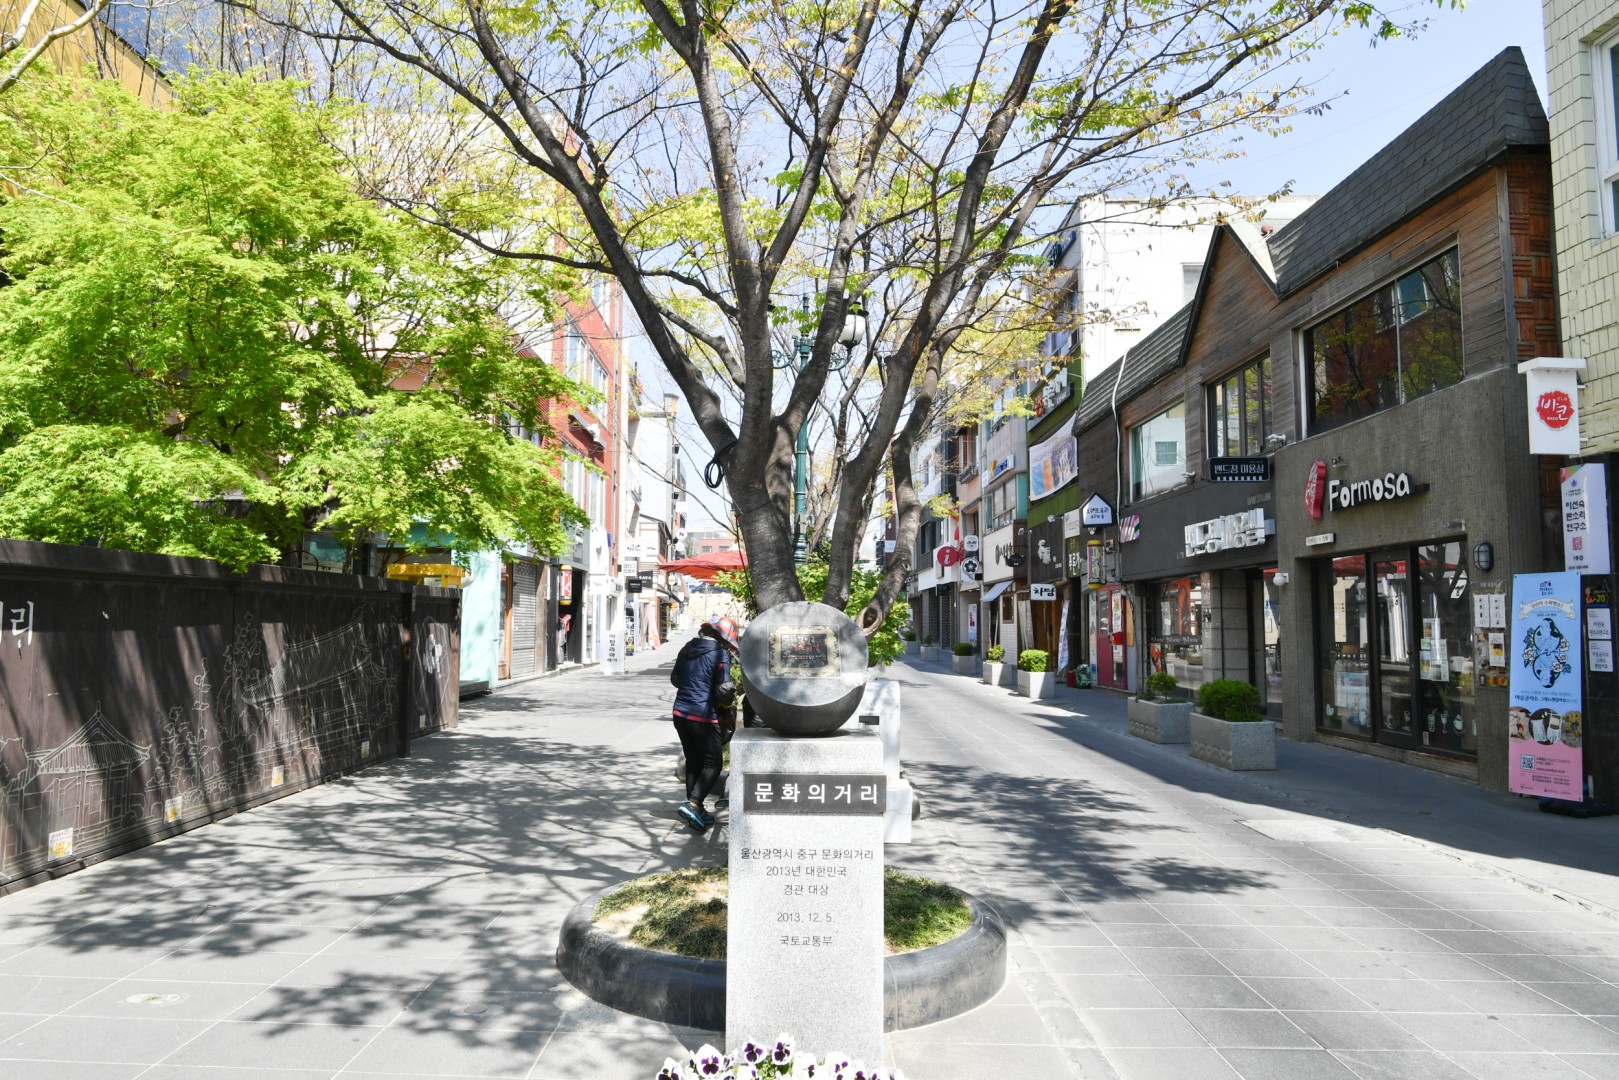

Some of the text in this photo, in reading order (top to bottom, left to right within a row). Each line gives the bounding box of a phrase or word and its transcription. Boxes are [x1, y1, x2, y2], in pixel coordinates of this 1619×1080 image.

[1240, 464, 1265, 474] 미용실
[754, 783, 878, 805] 문화의거리
[740, 848, 874, 860] 울산광역시 중구 문화의거리
[766, 866, 847, 877] 2013년 대한민국
[783, 884, 829, 896] 경관 대상
[779, 935, 833, 947] 국토교통부
